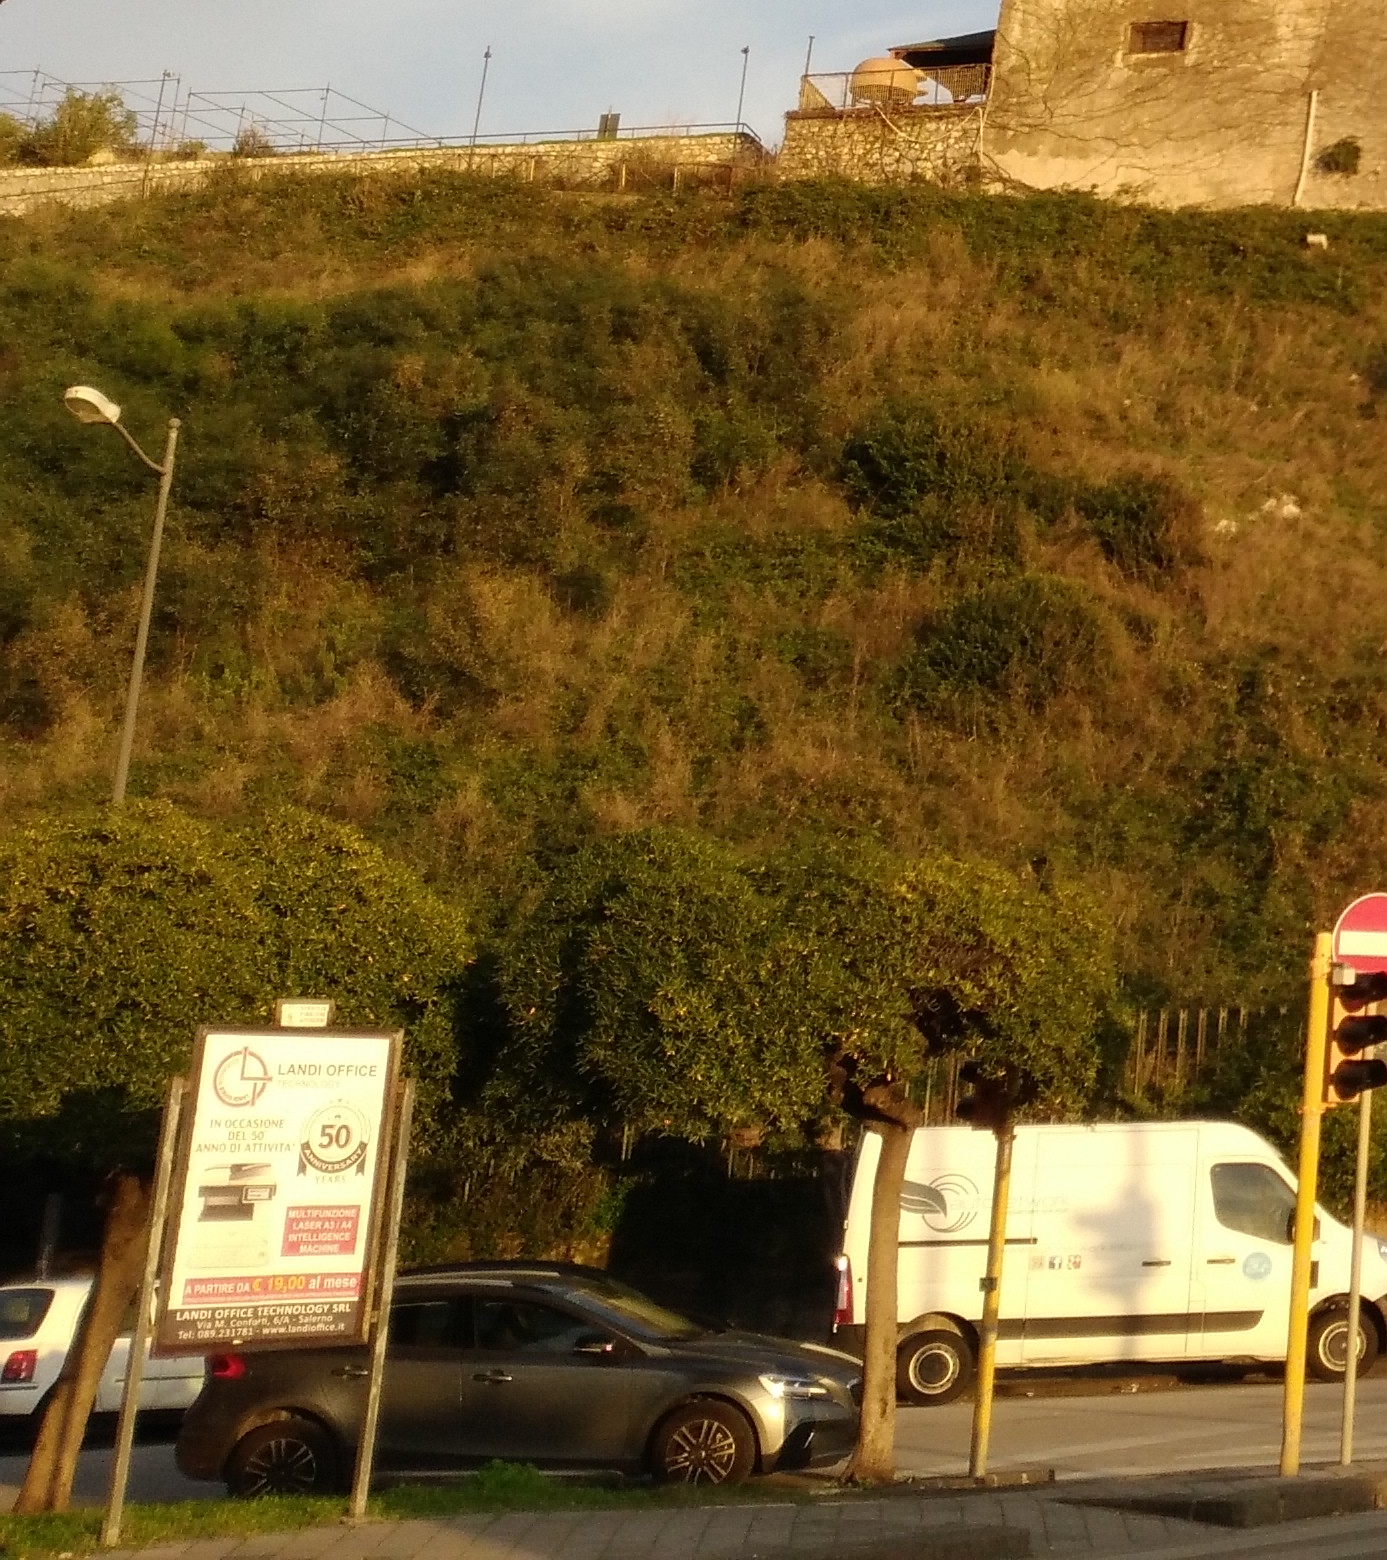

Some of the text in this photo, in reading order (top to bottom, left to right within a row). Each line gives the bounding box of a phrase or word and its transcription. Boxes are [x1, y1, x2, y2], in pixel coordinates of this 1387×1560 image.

[278, 1064, 378, 1077] LANDI OFFICE
[209, 1119, 285, 1129] IN OCCASIONE
[228, 1131, 247, 1140] DEL
[318, 1124, 353, 1149] 50
[195, 1142, 295, 1153] ANNO DI ATTIVITA'
[303, 1148, 364, 1170] ANNIVERSARY
[315, 1175, 346, 1183] YEARS
[287, 1209, 357, 1218] MULTIFUNZIONE
[293, 1221, 322, 1230] LASER
[323, 1221, 335, 1230] A3
[341, 1221, 352, 1230] A4
[288, 1232, 351, 1242] INTELLIGENCE
[299, 1244, 340, 1253] MACHINE
[185, 1276, 357, 1294] A PARTIRE DA € 19,00 al mese
[176, 1303, 351, 1321] LANDI OFFICE TECHNOLOGY SRL
[197, 1320, 212, 1330] Via
[214, 1319, 227, 1328] M.
[273, 1315, 290, 1325] 6/A
[299, 1313, 333, 1323] Salerno
[178, 1330, 195, 1340] Tel:
[197, 1328, 253, 1339] 089.231781
[262, 1322, 345, 1334] www.landioffice.it
